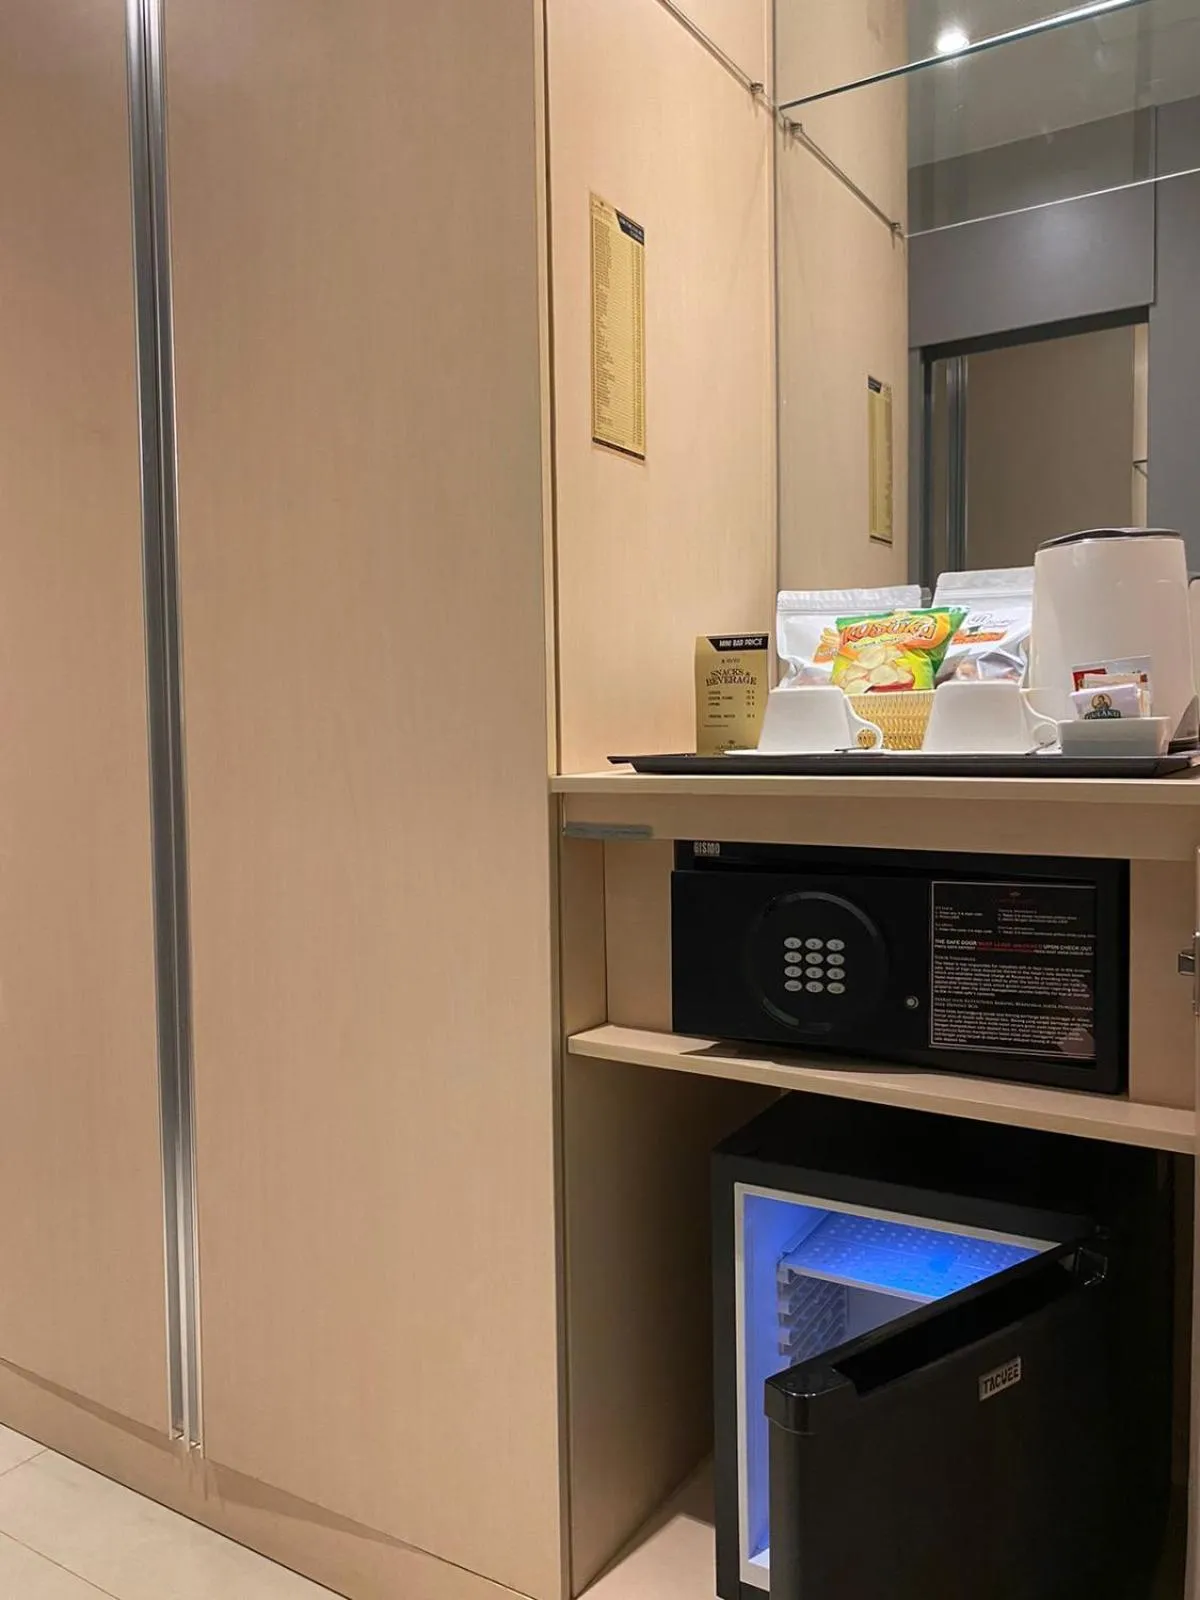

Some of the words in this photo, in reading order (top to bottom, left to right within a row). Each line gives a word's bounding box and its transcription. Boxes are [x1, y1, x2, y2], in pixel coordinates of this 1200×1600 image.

[719, 639, 732, 647] MINI
[745, 638, 763, 646] PRICE
[710, 668, 744, 676] SNACKS
[705, 676, 757, 687] BEVERAGE
